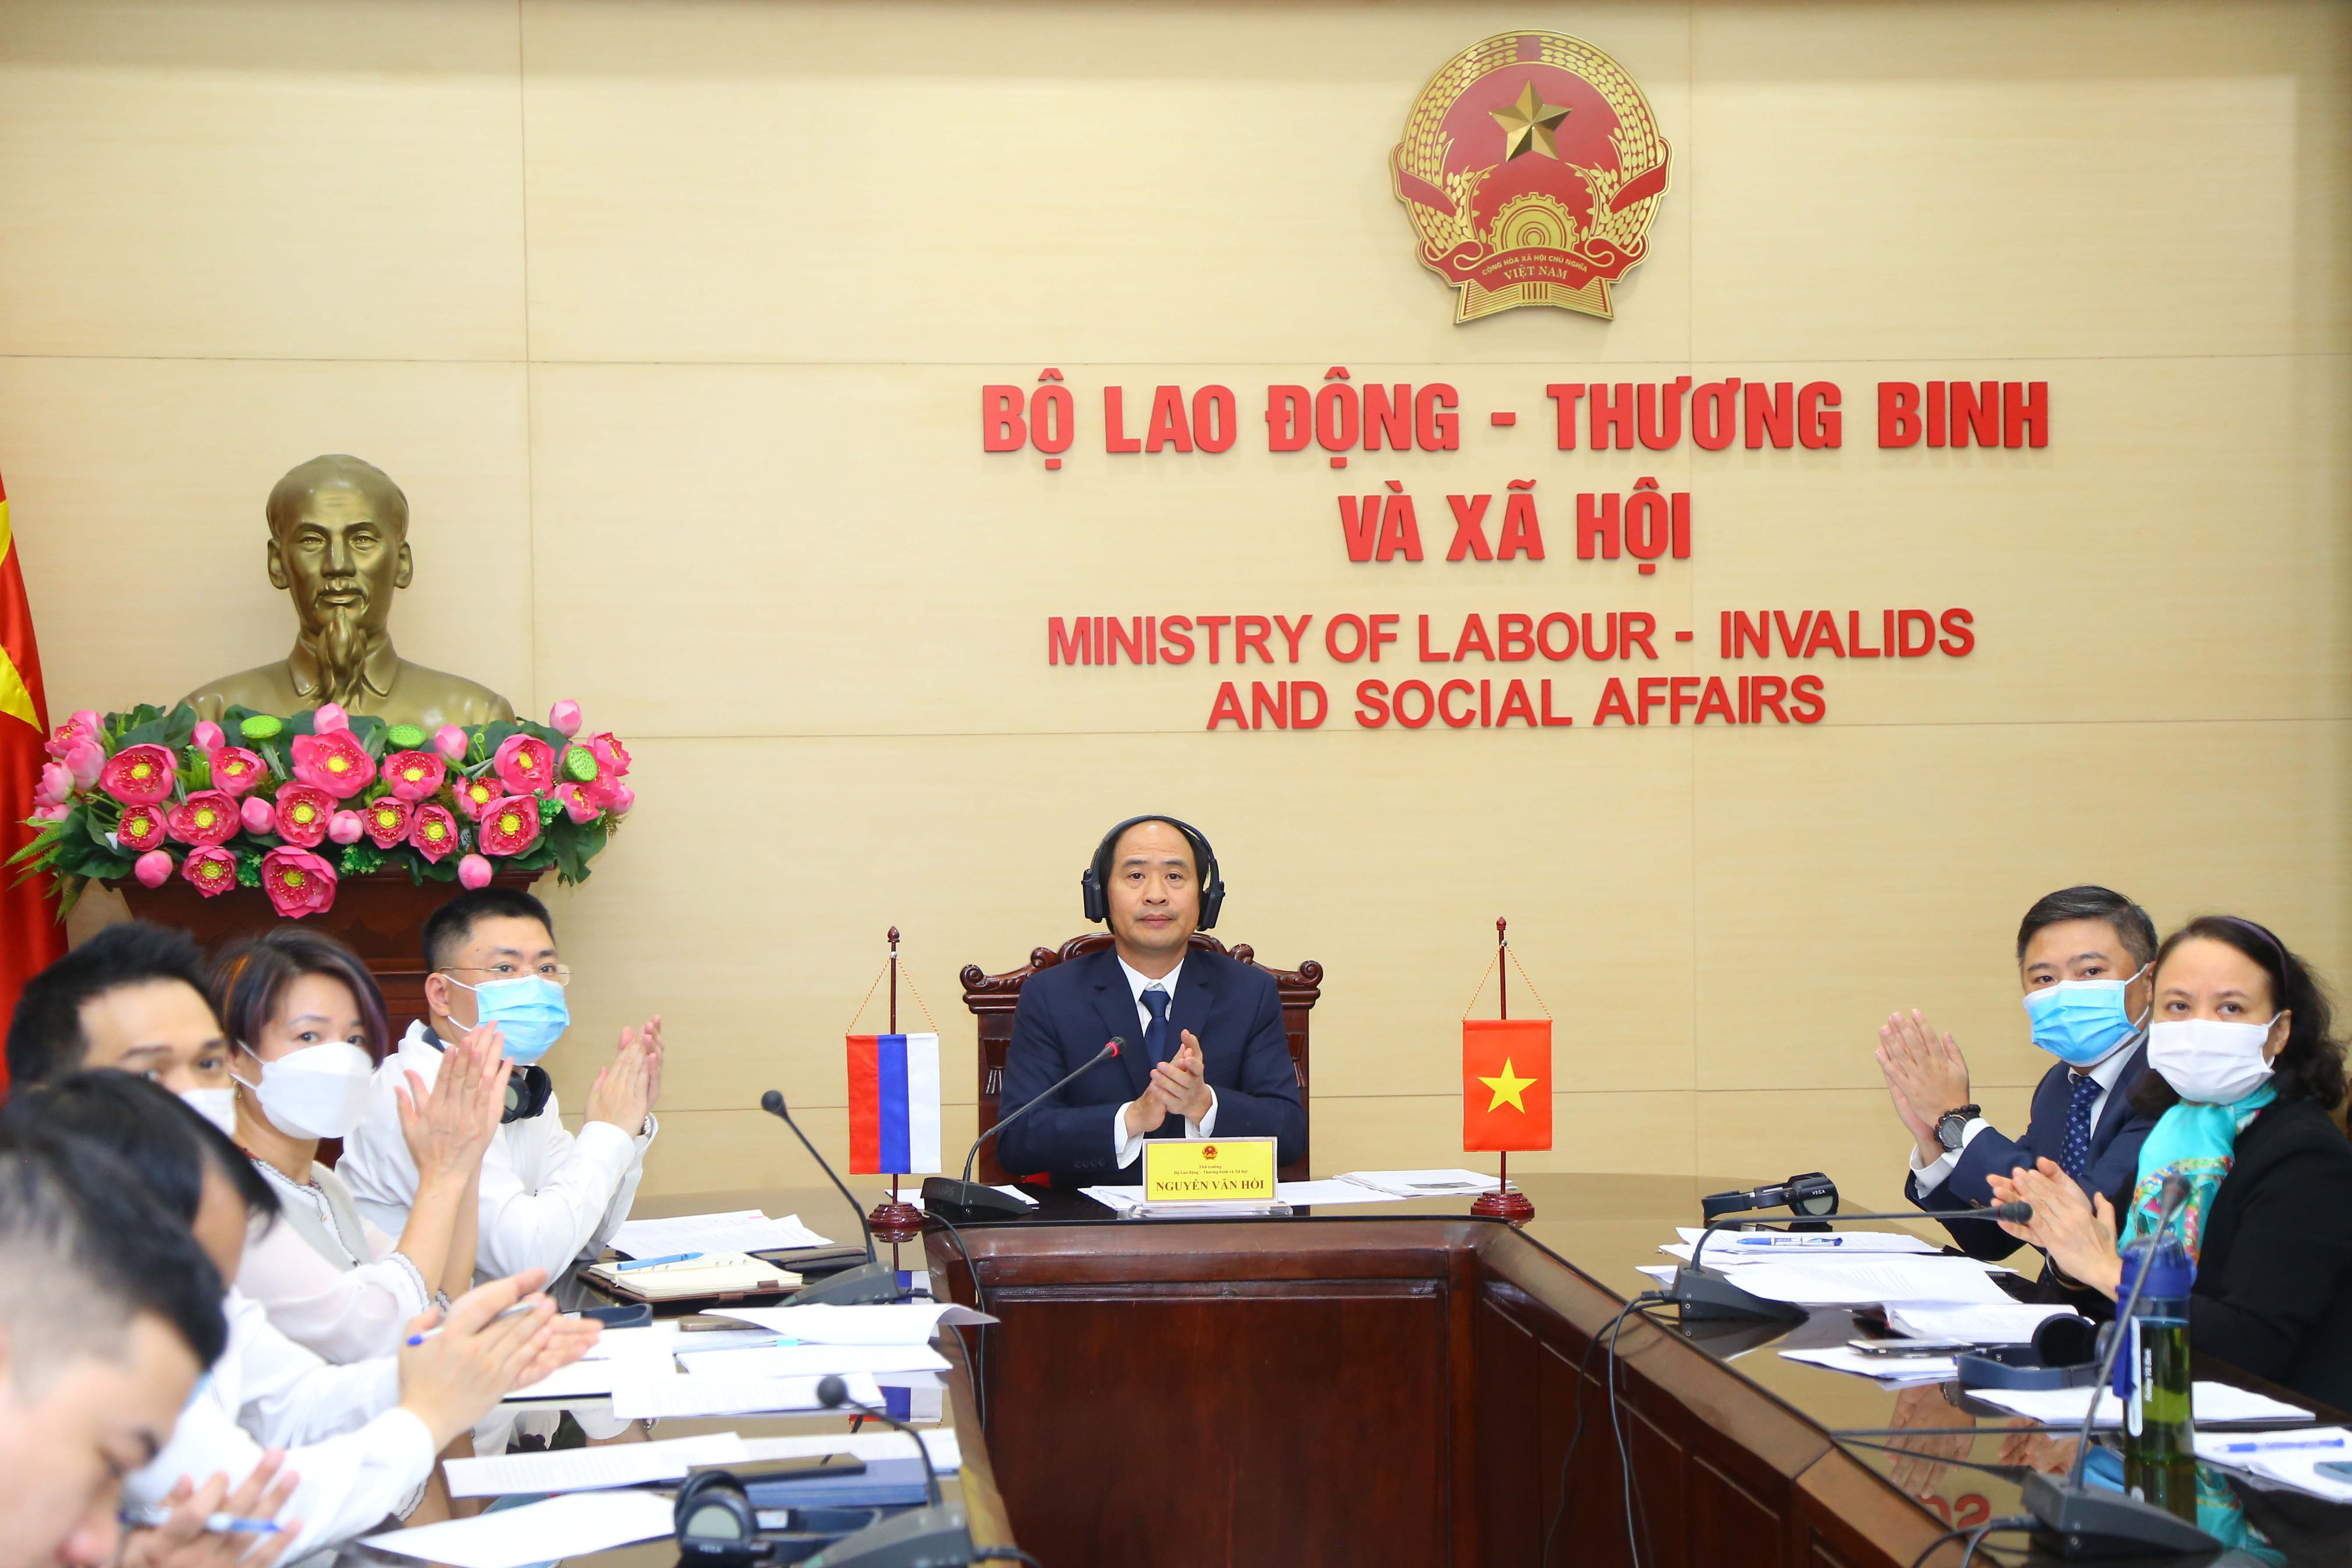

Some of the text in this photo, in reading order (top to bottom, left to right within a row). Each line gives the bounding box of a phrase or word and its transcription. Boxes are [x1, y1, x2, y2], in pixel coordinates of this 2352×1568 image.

[1503, 264, 1568, 280] VIỆT NAM
[983, 367, 1075, 470] BỘ
[1104, 385, 1237, 454] LAO
[1265, 366, 1460, 469] ĐỘNG
[1546, 375, 1842, 451] THƯƠNG
[1878, 381, 2049, 449] BINH
[1338, 476, 1692, 575] VÀ XÃ HỘI
[1048, 614, 1313, 665] MINISTRY
[1325, 613, 1400, 663] OF
[1419, 611, 1659, 662] LABOUR
[1720, 607, 1975, 659] INVALIDS
[1207, 675, 1826, 730] AND SOCIAL AFFAIRS
[1156, 1178, 1209, 1191] NGUYỄN
[1212, 1178, 1237, 1190] VĂN
